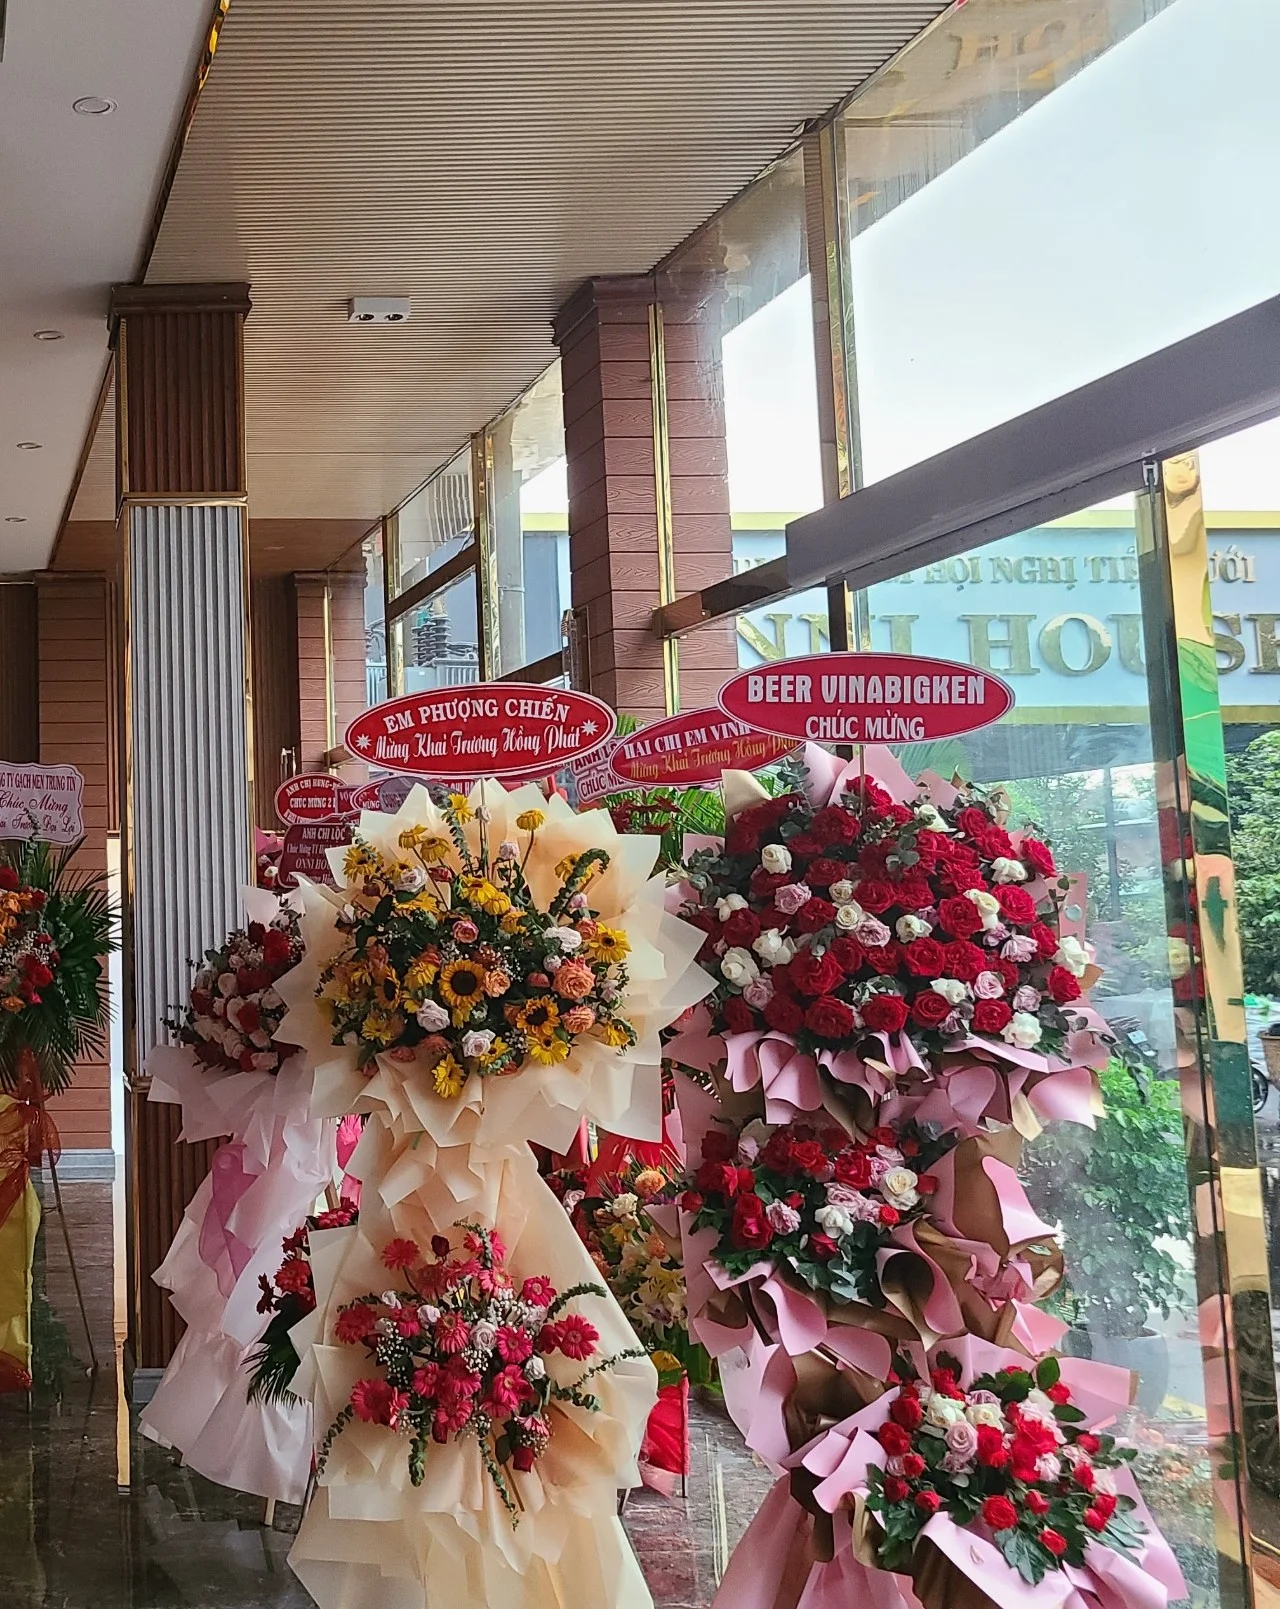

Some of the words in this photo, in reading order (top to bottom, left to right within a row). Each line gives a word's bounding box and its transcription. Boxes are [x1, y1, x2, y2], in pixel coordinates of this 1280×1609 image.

[989, 556, 1077, 590] NGHỊ
[747, 675, 812, 703] BEER
[822, 675, 985, 705] VINABIGKEN
[383, 710, 415, 734] EM
[418, 698, 499, 723] PHƯỢNG
[505, 695, 571, 723] CHIẾN
[805, 709, 858, 740] CHÚC
[864, 709, 925, 740] MỪNG
[373, 735, 410, 763] Mừng
[413, 732, 448, 758] Khai
[450, 729, 498, 758] Trương
[501, 725, 542, 756] Hồng
[543, 723, 581, 754] Phát
[623, 740, 652, 760] HAI
[654, 733, 682, 753] CHỊ
[684, 728, 707, 747] EM
[630, 761, 659, 780] Mừng
[661, 752, 689, 775] Khai
[692, 746, 731, 767] Trương
[732, 736, 766, 759] Hồng
[580, 771, 607, 797] CHÚC
[29, 793, 69, 818] Mừng
[302, 827, 317, 840] ANH
[317, 827, 330, 842] CHỊ
